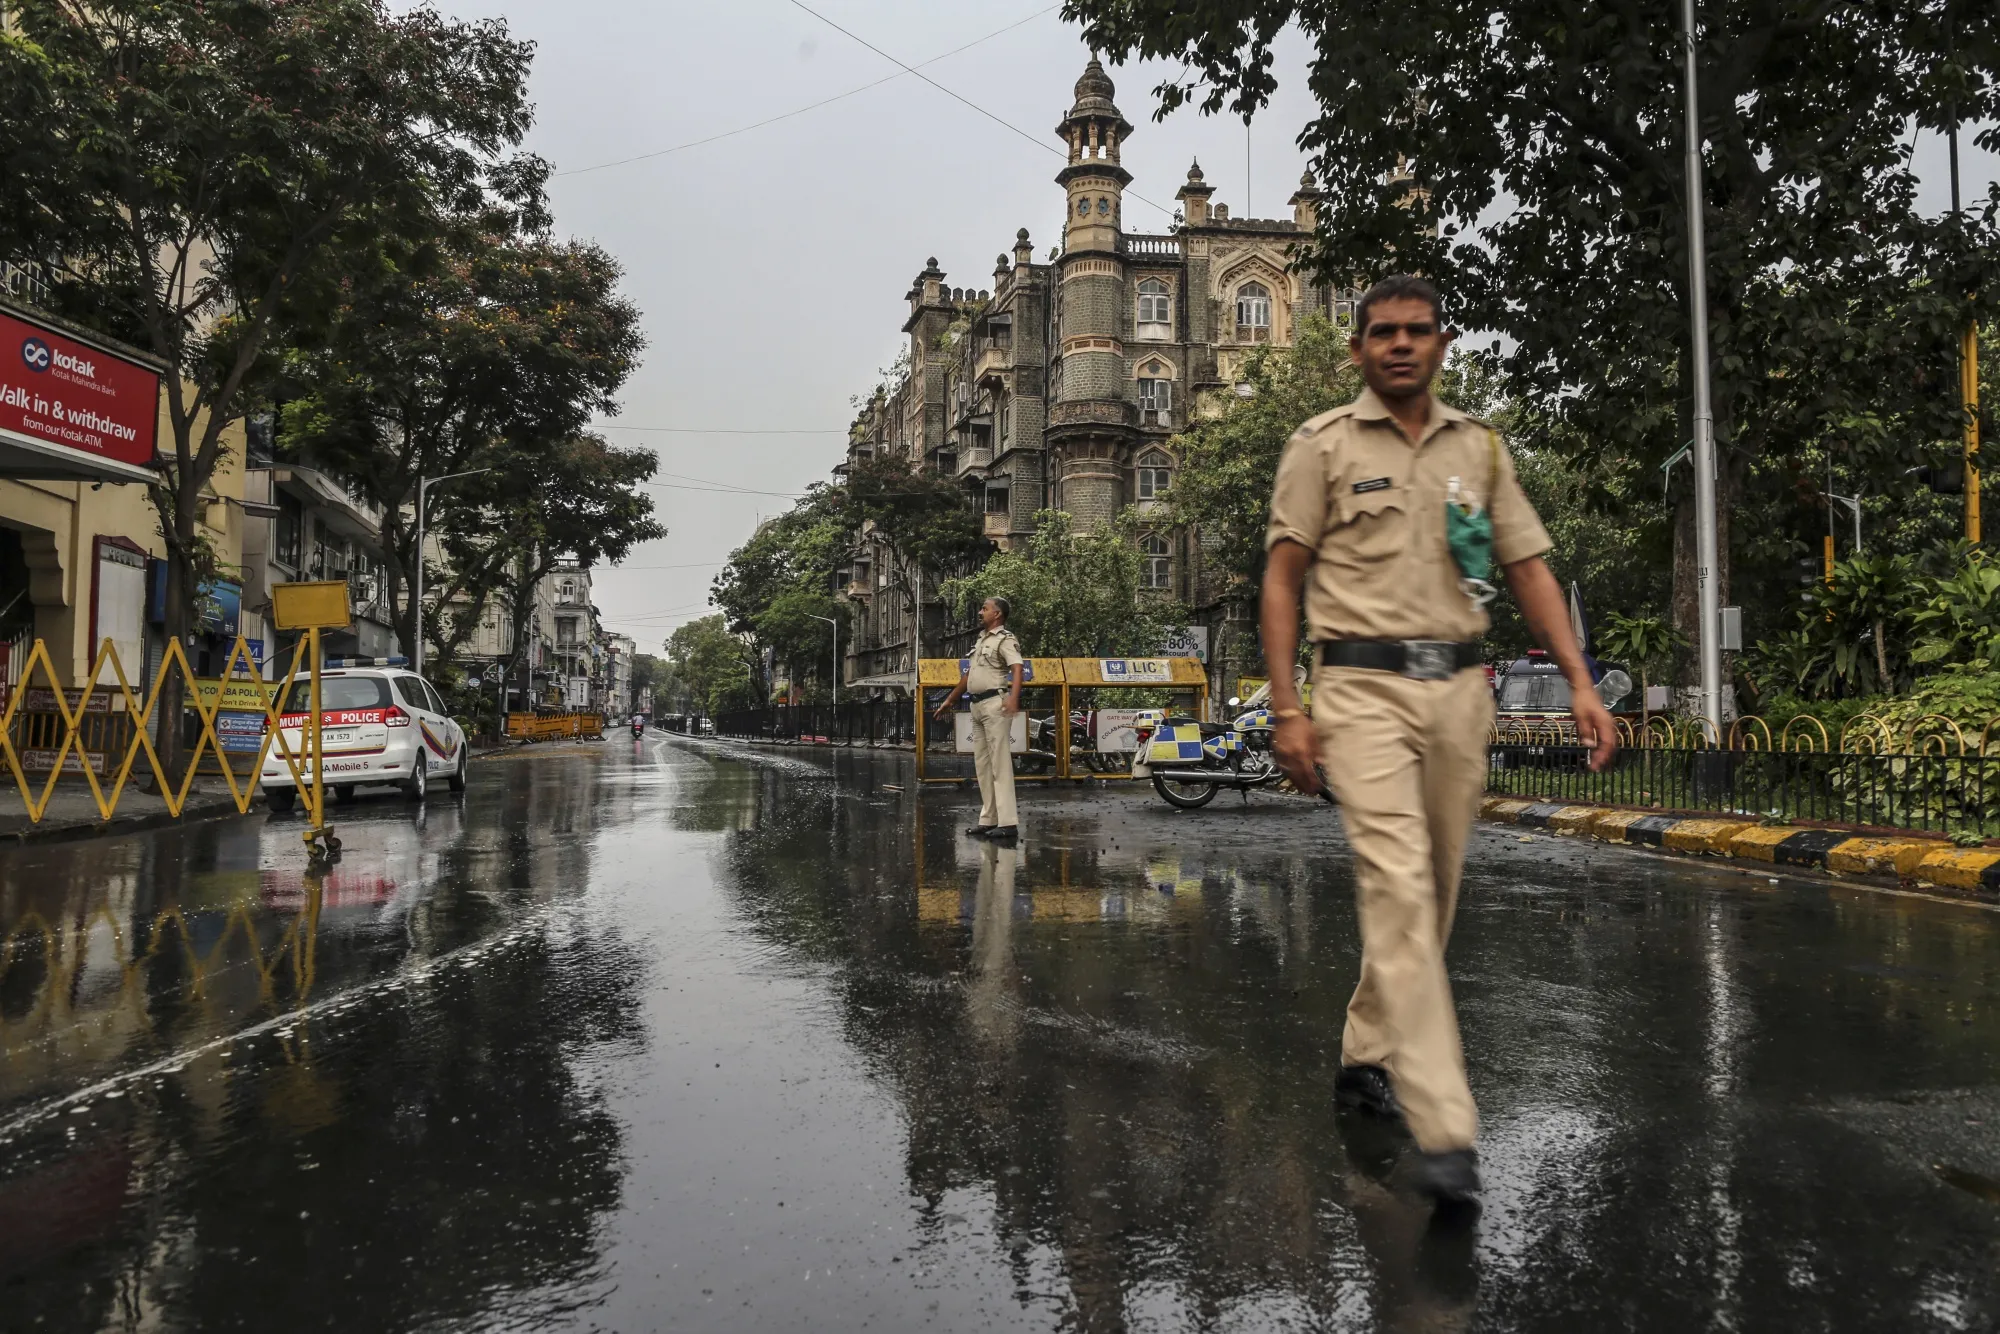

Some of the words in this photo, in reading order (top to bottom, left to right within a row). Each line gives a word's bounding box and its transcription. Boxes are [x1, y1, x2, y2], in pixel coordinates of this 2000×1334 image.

[53, 349, 95, 379] kotak
[52, 368, 70, 381] Kotak
[72, 375, 100, 391] Mahindra
[102, 386, 116, 396] Bank
[34, 393, 48, 415] in
[53, 401, 64, 420] &
[68, 409, 136, 441] withdraw
[23, 415, 44, 432] from
[45, 424, 60, 436] our
[61, 428, 83, 442] Kotak
[84, 434, 103, 448] ATM.
[1168, 638, 1198, 650] 80%
[1133, 662, 1157, 673] LIC
[239, 689, 266, 697] POLIC
[280, 716, 310, 727] MUM
[341, 713, 379, 723] POLICE
[332, 762, 361, 771] Mobile
